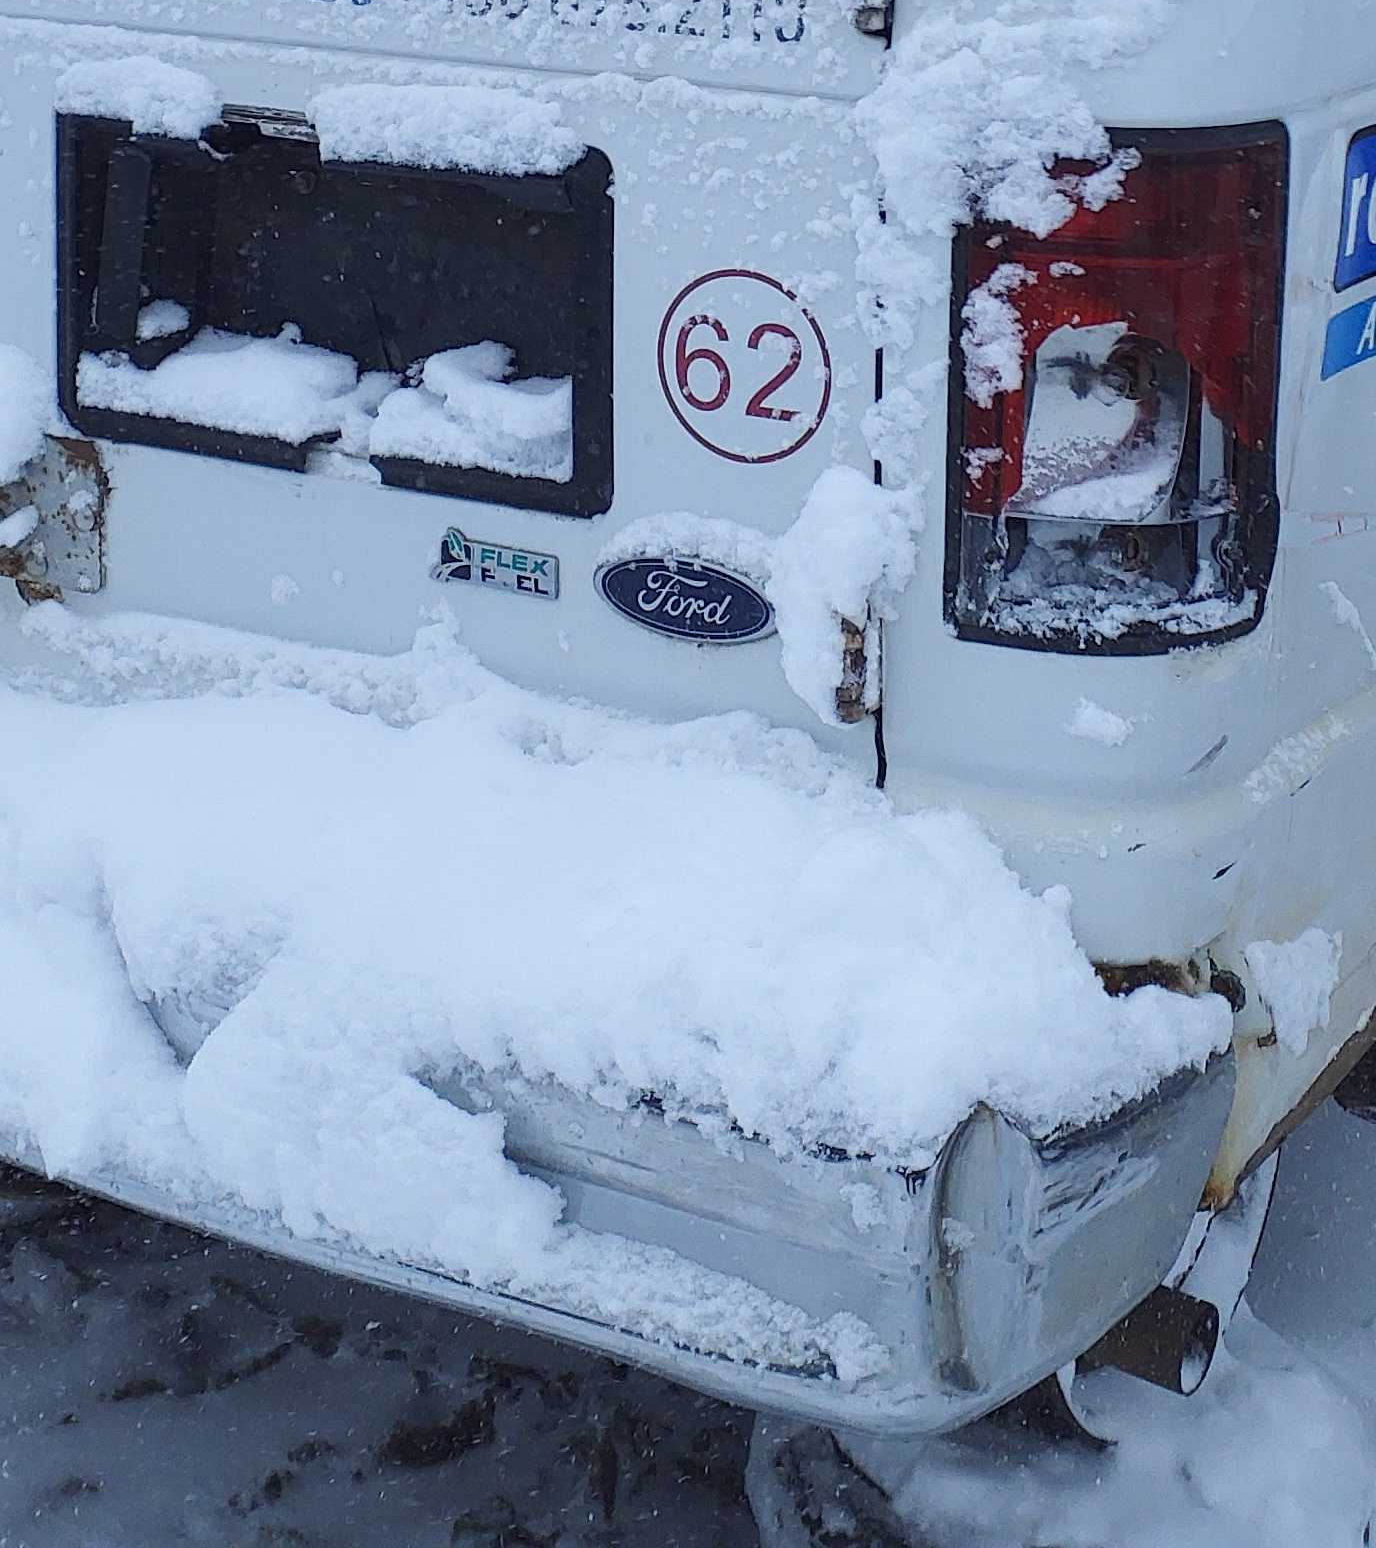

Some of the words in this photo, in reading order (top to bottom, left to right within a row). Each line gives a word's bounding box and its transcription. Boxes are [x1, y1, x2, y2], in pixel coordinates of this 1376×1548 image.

[676, 314, 802, 422] 62
[480, 547, 549, 577] FLEX
[481, 567, 549, 596] FEL
[638, 570, 732, 626] Ford
